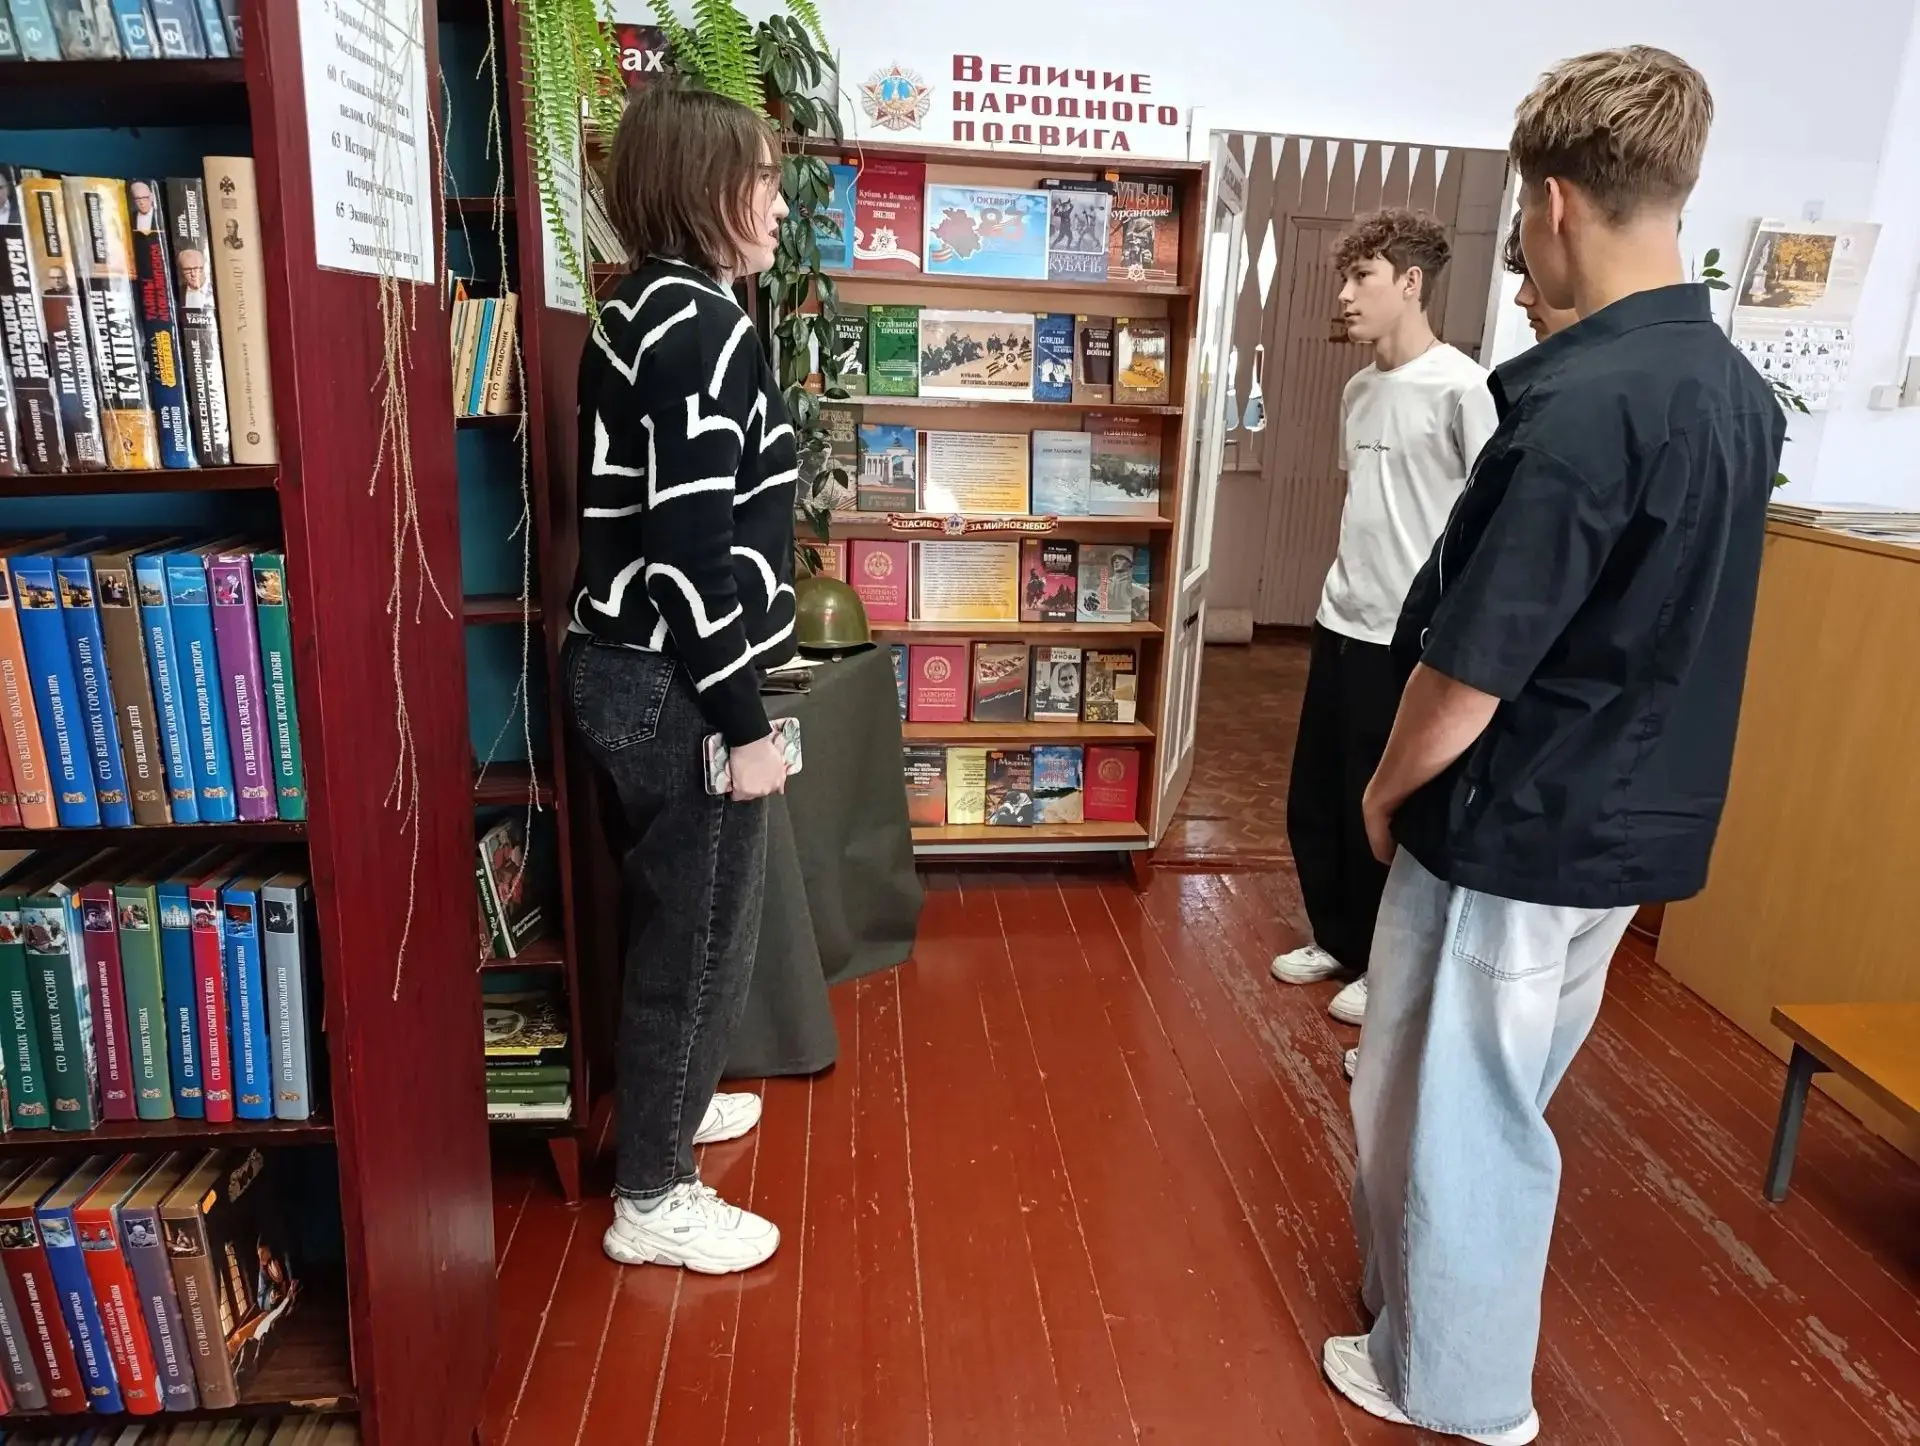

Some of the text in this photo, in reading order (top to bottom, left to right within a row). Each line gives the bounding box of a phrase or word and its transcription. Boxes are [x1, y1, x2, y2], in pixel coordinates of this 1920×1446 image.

[327, 63, 337, 82] 60
[953, 54, 1152, 94] ВЕЛИЧИЕ
[953, 90, 1179, 126] НАРОДНОГО
[331, 130, 341, 149] 63
[953, 120, 1131, 152] ПОДВИГА
[186, 189, 201, 239] ПРОКОПЕНКО
[336, 200, 345, 218] 65
[5, 237, 50, 380] ДРЕВНЕЙ РУСИ
[1, 294, 27, 379] ЗАГАДКИ
[53, 329, 77, 395] ПРАВДА
[73, 346, 92, 409] СОВЕТСКОМ
[161, 405, 172, 429] ИГОРЬ
[191, 339, 213, 453] САМЫЕ СЕНСАЦИОННЫЕ
[171, 406, 186, 452] ПРОКОПЕНКО
[897, 519, 939, 529] СПАСИБО
[983, 521, 1022, 531] МИРНОЕ
[152, 626, 166, 658] ГОРОДОВ
[2, 659, 35, 781] СТО ВЕЛИКИХ ВОКАЛИСТОВ
[47, 673, 75, 781] СТО ВЕЛИКИХ ГОРОДОВ МИРА
[77, 635, 113, 780] СТО ВЕЛИКИХ ГОРОДОВ МИРА
[191, 640, 217, 775] СТО ВЕЛИКИХ РЕКОРДОВ ТРАНСПОРТА
[234, 674, 257, 776] СТО ВЕЛИКИХ РАЗВЕДЧИКОВ
[270, 651, 294, 776] СТО ВЕЛИКИХ ИСТОРИЙ ЛЮБВИ
[127, 705, 150, 779] СТО ВЕЛИКИХ ДЕТЕЙ
[169, 733, 183, 764] ВЕЛИКИХ
[174, 765, 185, 779] СТО
[204, 976, 216, 993] ВЕКА
[11, 989, 34, 1093] СТО ВЕЛИКИХ РОССИЯН
[43, 970, 68, 1073] СТО ВЕЛИКИХ РОССИЯН
[139, 1007, 153, 1079] СТО ВЕЛИКИХ УЧЕНЫХ
[180, 1007, 194, 1077] СТО ВЕЛИКИХ ХРАМОВ
[204, 1005, 217, 1037] СОБЫТИЙ
[209, 1037, 221, 1066] ВЕЛИКИХ
[212, 1067, 221, 1080] СТО
[281, 1038, 292, 1068] ВЕЛИКИХ
[283, 1068, 293, 1081] СТО
[152, 1295, 180, 1377] СТО ВЕЛИКИХ ПОЛИТИКОВ
[185, 1275, 211, 1356] СТО ВЕЛИКИХ УЧЕНЫХ
[51, 1368, 61, 1380] СТО
[89, 1366, 100, 1378] СТО
